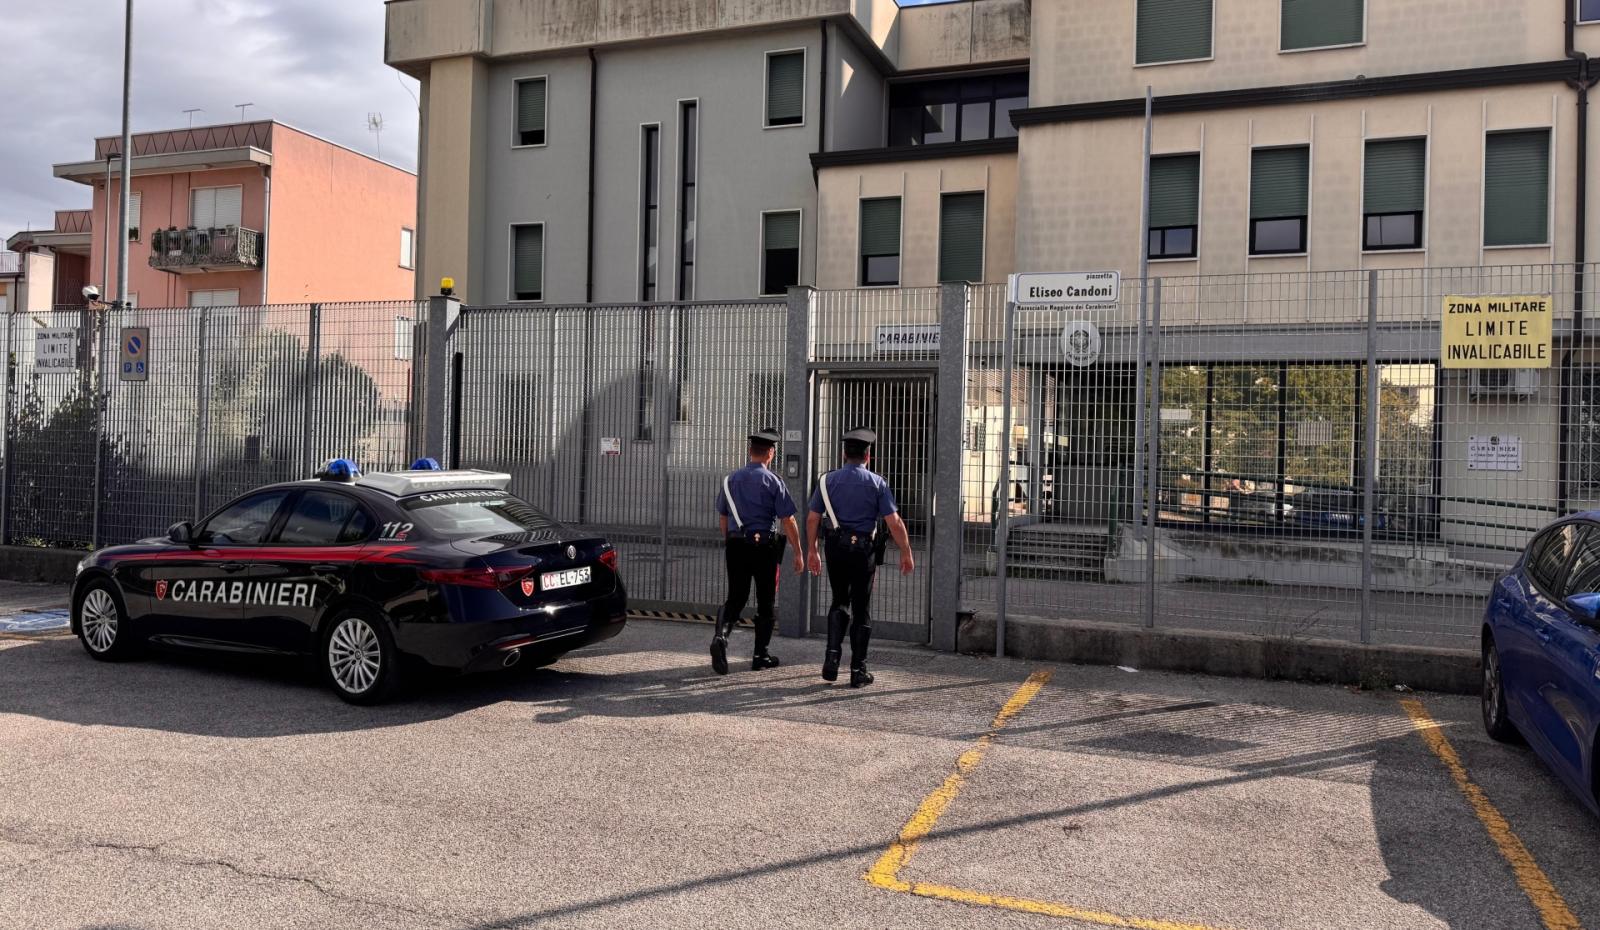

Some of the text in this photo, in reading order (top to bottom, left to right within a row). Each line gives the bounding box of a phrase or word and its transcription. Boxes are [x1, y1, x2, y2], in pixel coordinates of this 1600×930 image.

[1029, 284, 1113, 298] Eliseo Candoni
[1049, 304, 1074, 312] Maggiore
[1448, 301, 1546, 314] ZONA MILITARE
[1466, 320, 1528, 336] LIMITE
[51, 331, 74, 339] MILITARE
[879, 332, 940, 345] CARABINIE
[43, 343, 68, 354] LIMITE
[1447, 343, 1547, 360] INVALICABILE
[36, 357, 74, 368] INVALICABILE
[380, 521, 414, 539] 112
[543, 573, 556, 588] CC
[171, 579, 318, 608] CARABINIERI
